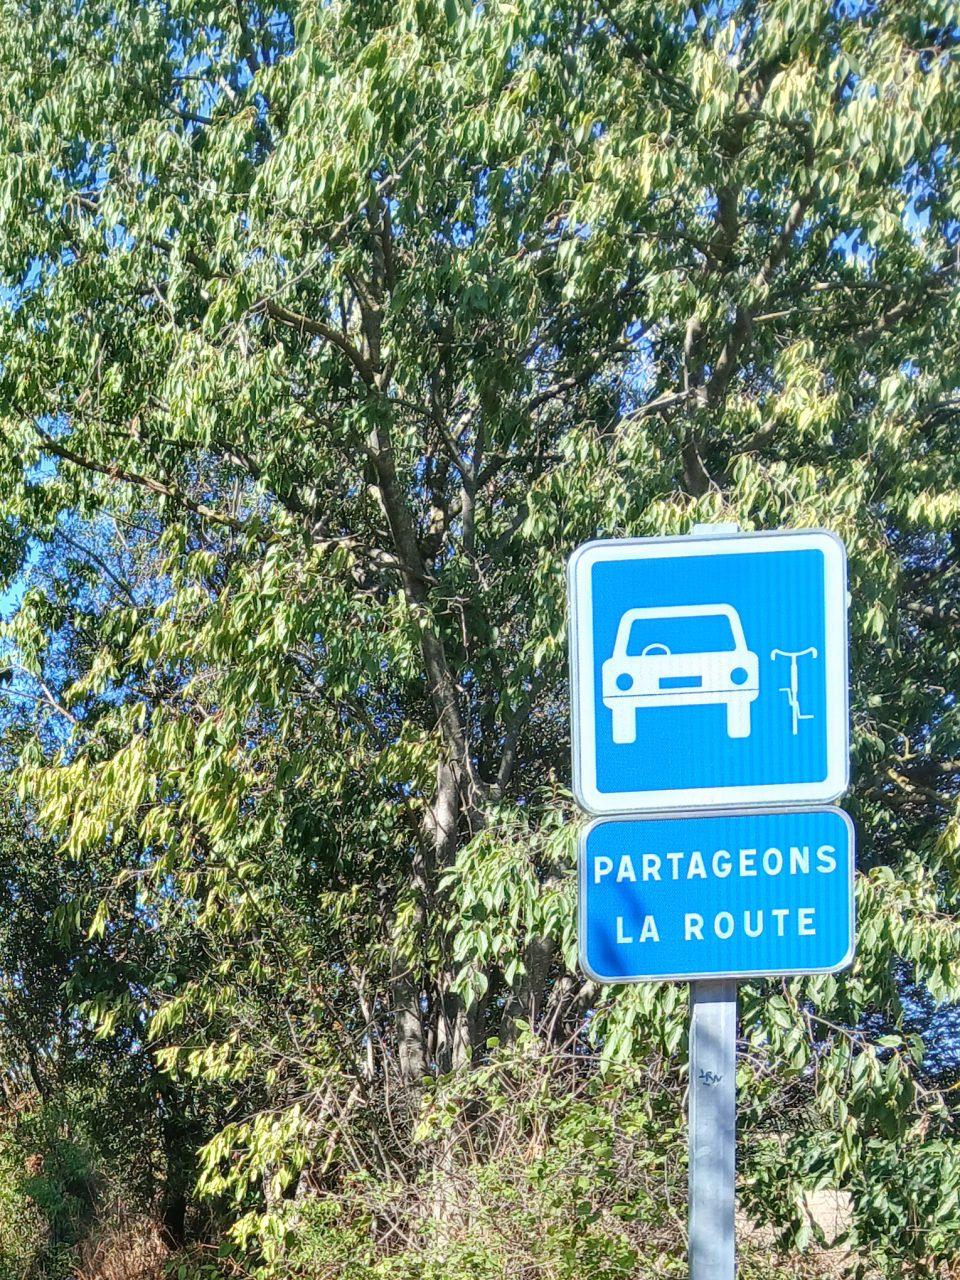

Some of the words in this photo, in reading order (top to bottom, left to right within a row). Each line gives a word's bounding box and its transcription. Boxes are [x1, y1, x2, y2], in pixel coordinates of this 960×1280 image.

[594, 845, 837, 884] PARTAGEONS
[616, 914, 660, 944] LA
[685, 908, 816, 941] ROUTE
